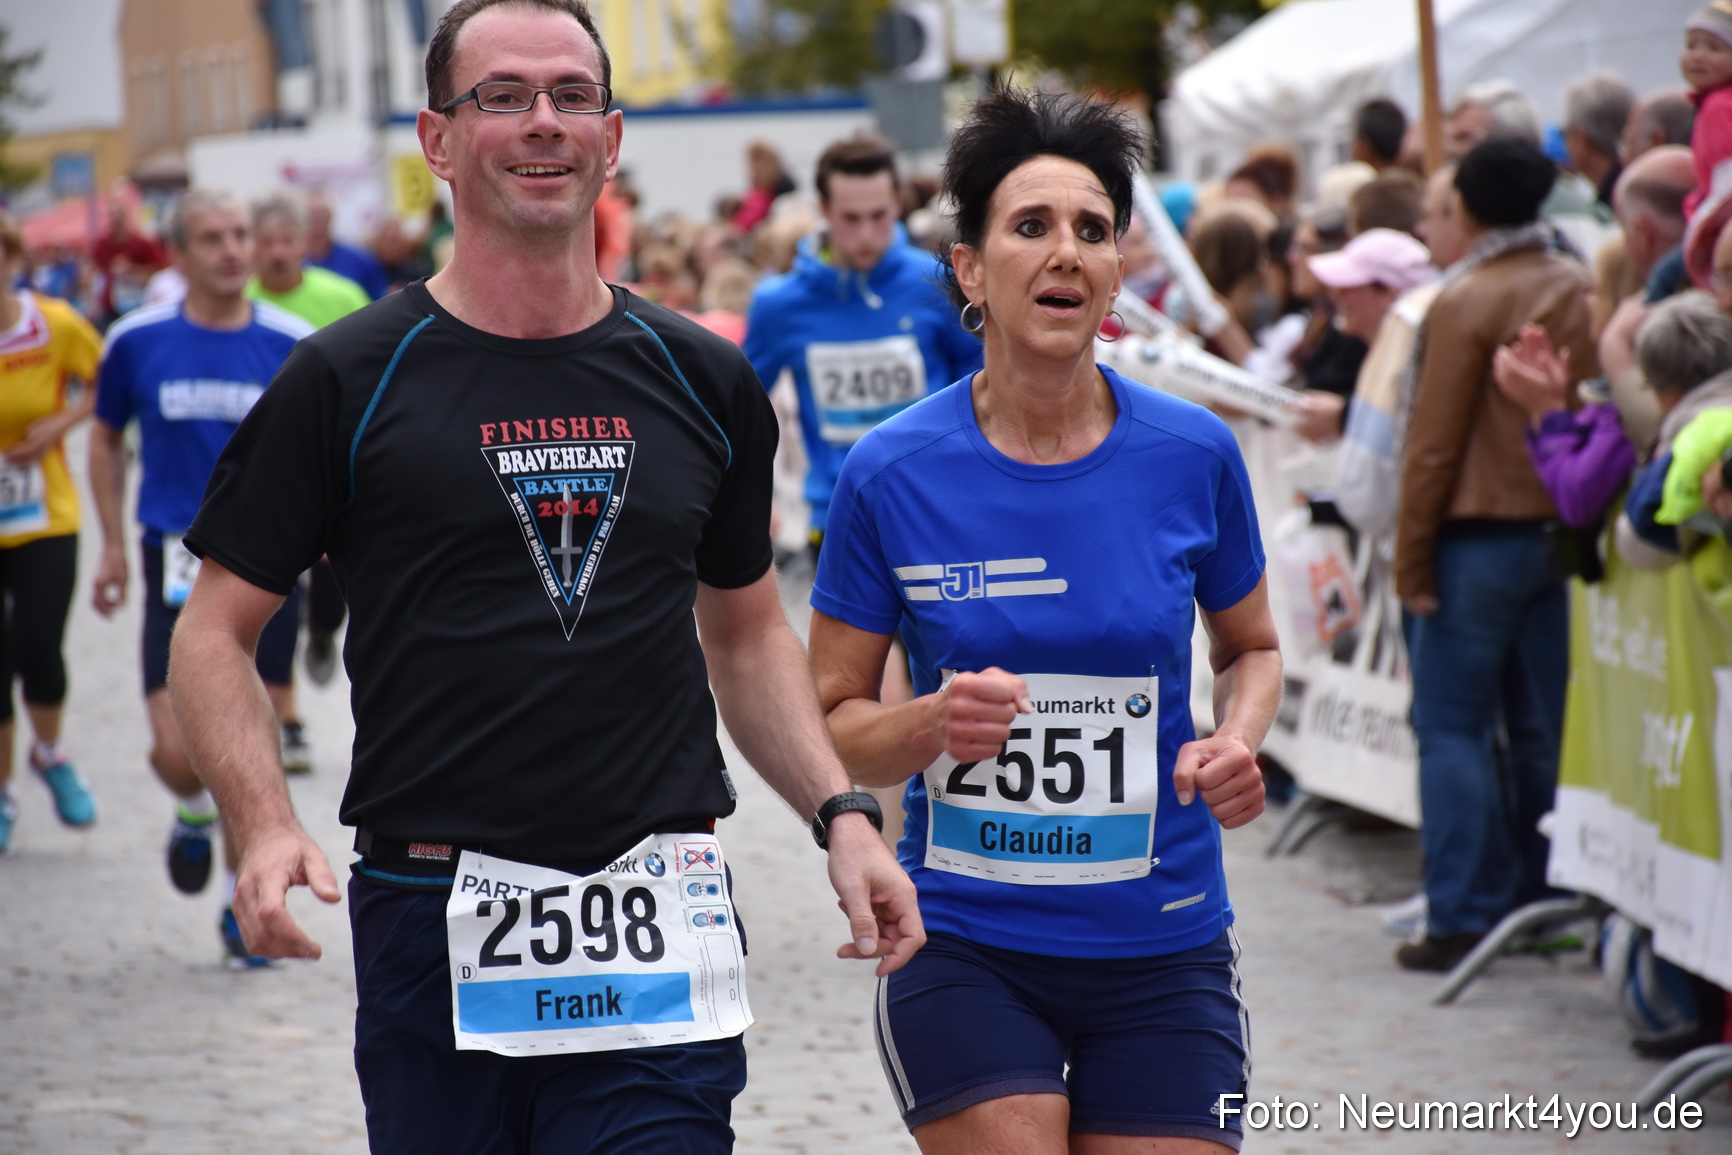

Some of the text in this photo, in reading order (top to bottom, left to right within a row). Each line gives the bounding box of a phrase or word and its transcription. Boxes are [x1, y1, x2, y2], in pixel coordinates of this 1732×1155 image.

[823, 363, 914, 404] 2409
[479, 417, 632, 444] FINISHER
[497, 446, 626, 474] BRAVEHEART
[523, 477, 608, 496] BATTLE
[537, 498, 599, 517] 2014
[510, 492, 530, 523] DURCH
[524, 523, 535, 539] DIE
[542, 568, 560, 598] GEHEN
[576, 553, 597, 597] POWERED
[592, 539, 602, 553] BY
[1017, 696, 1115, 714] umarkt
[945, 727, 1125, 804] 2551
[933, 786, 941, 799] D
[980, 821, 1092, 855] Claudia
[476, 884, 665, 968] 2598
[462, 966, 471, 980] D
[536, 986, 623, 1021] Frank
